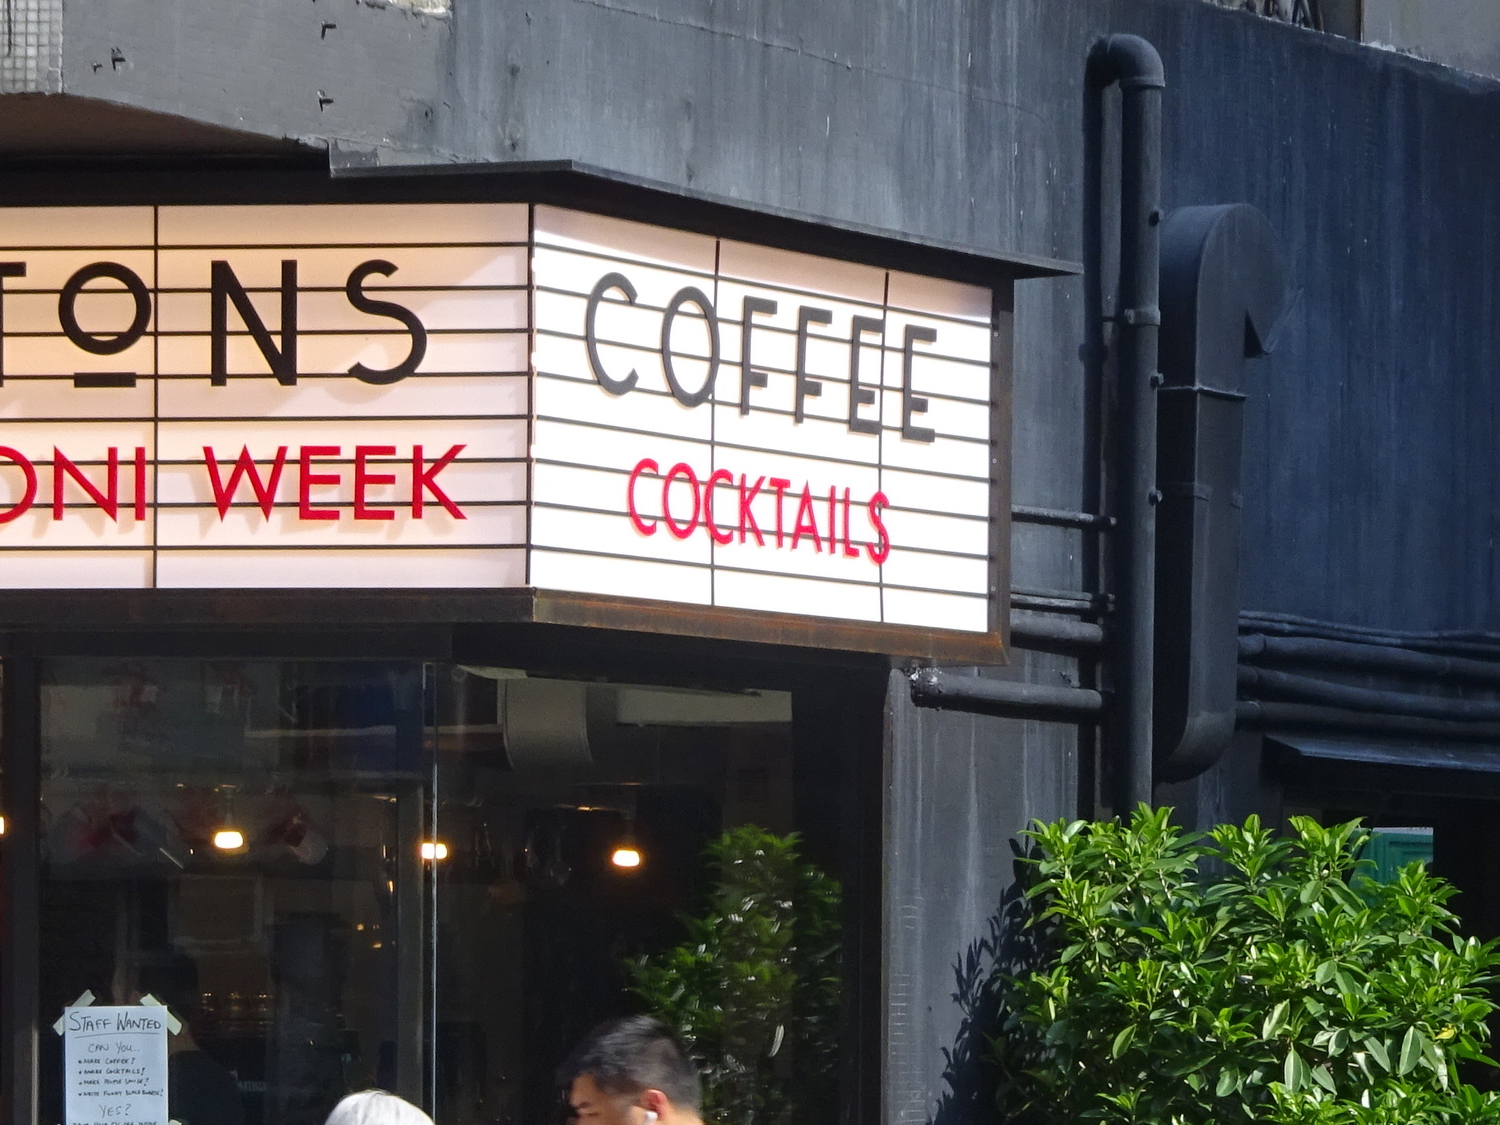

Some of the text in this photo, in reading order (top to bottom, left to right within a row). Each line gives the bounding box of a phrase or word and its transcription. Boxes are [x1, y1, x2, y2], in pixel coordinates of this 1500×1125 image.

[585, 271, 938, 443] COFFEE
[202, 443, 469, 523] WEEK
[627, 457, 891, 565] COCKTAILS
[69, 1011, 162, 1033] STAFF WANTED
[88, 1043, 109, 1053] CAN
[99, 1103, 132, 1119] YES?
